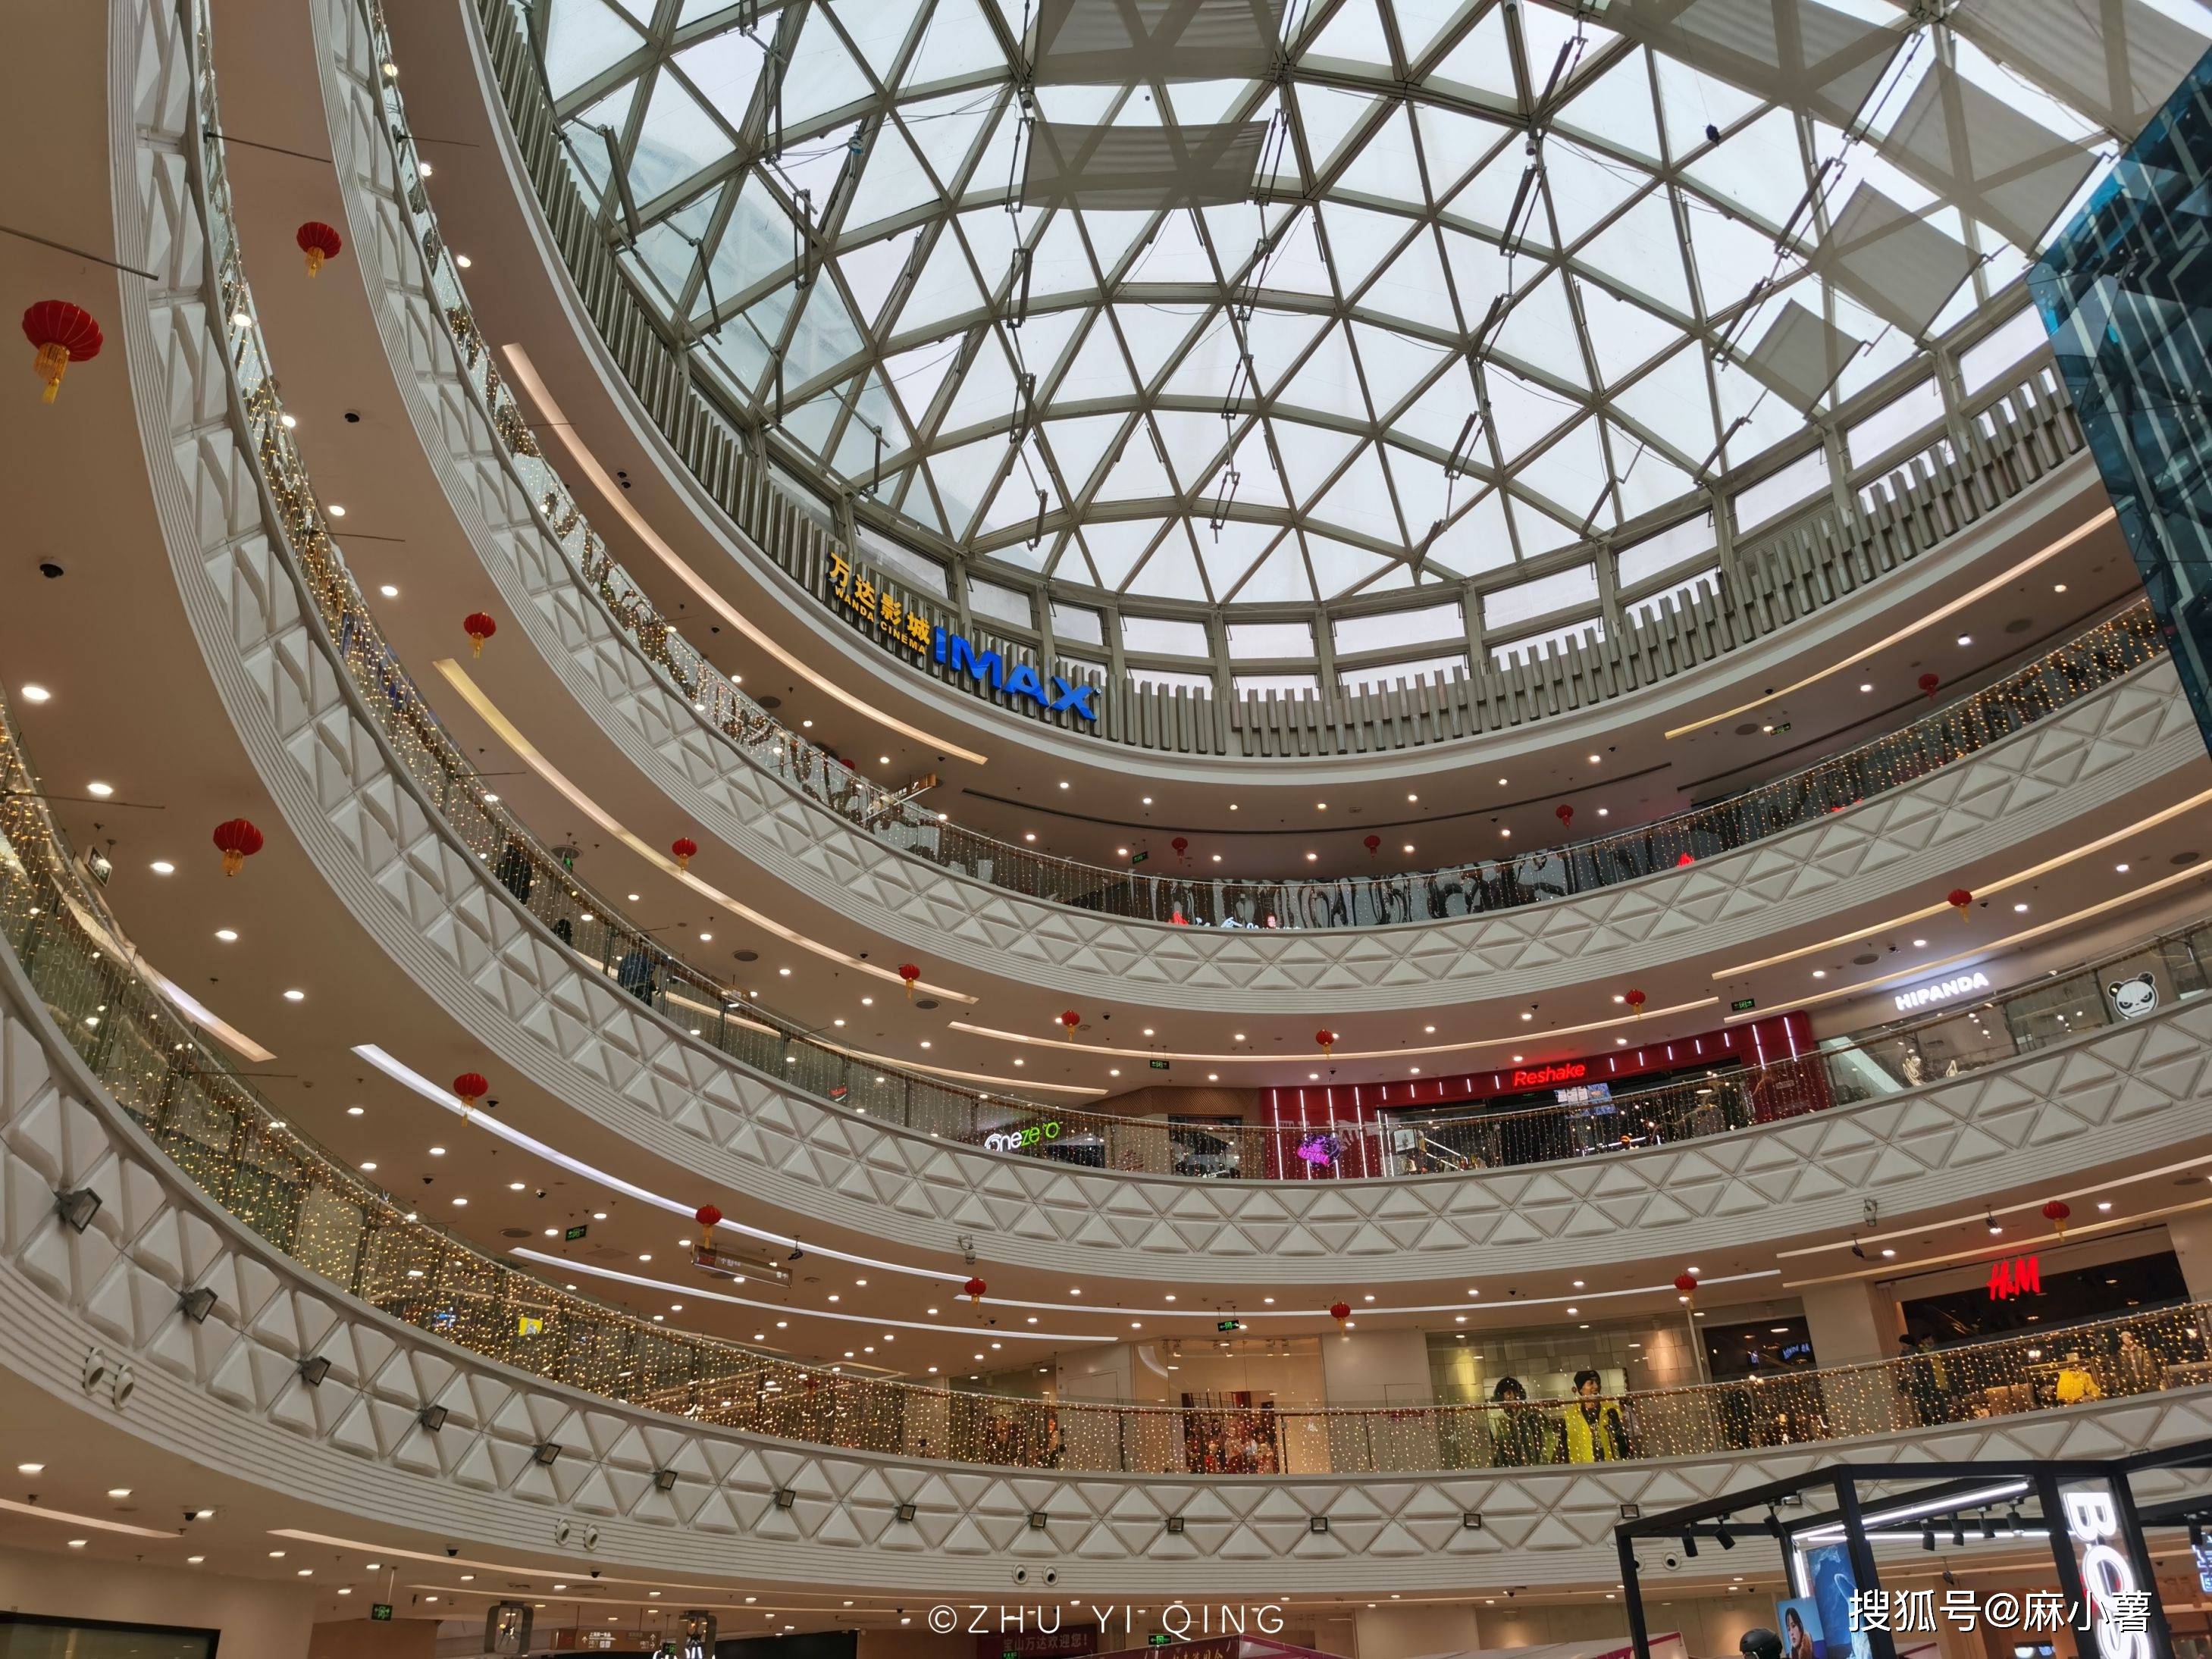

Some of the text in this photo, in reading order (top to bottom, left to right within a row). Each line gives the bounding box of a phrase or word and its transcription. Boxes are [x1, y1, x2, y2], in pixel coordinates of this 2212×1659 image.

[830, 552, 930, 645] 万达影城
[835, 585, 926, 656] WANDA CINEMA
[933, 626, 1097, 722] IMAX
[1894, 972, 1990, 1011] HIPANDA
[1514, 1063, 1586, 1087] Reshake
[984, 1122, 1060, 1152] onezeo
[1986, 1255, 2040, 1301] H&M
